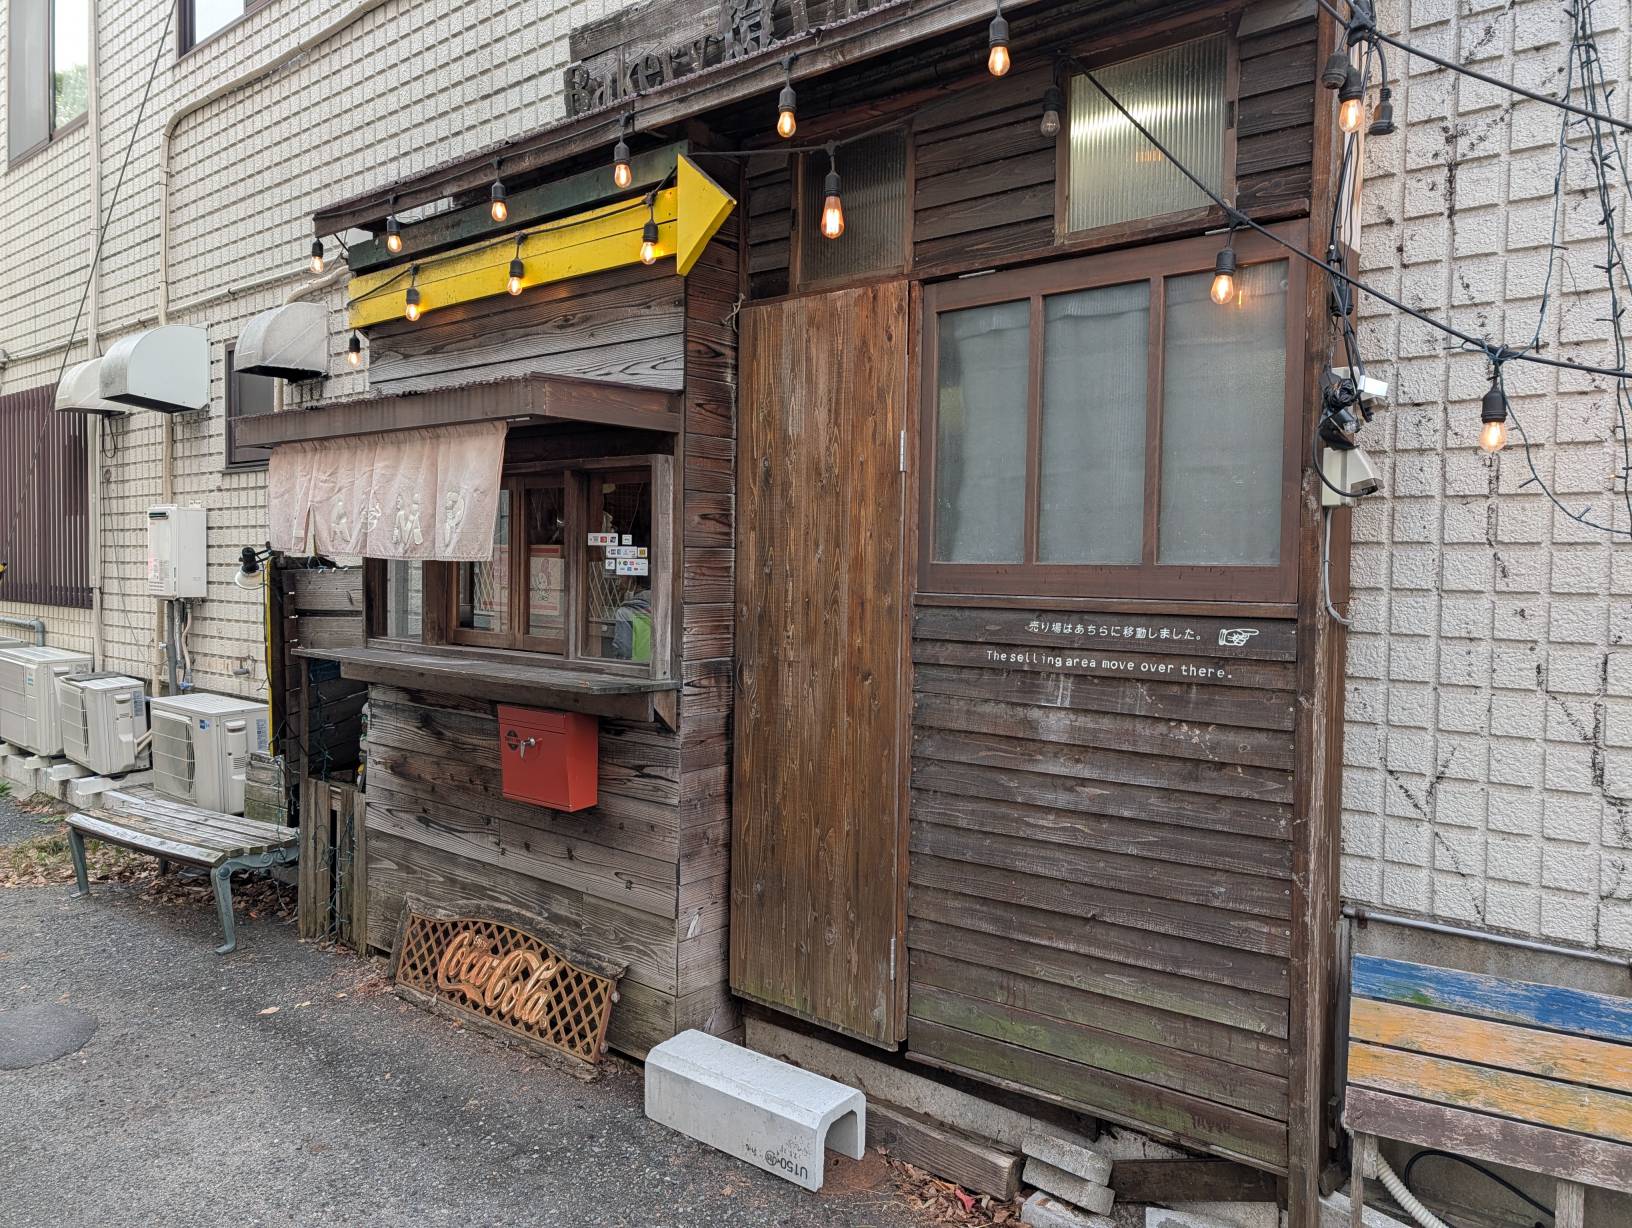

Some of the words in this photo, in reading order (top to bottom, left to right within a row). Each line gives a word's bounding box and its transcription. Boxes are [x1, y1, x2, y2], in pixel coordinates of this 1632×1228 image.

[1028, 620, 1201, 641] 売り場はあちらに移動しました。
[986, 650, 1007, 661] The
[1009, 652, 1063, 667] selling
[1065, 657, 1096, 668] area
[1101, 659, 1135, 671] move
[1140, 662, 1174, 673] over
[1180, 663, 1232, 679] there.
